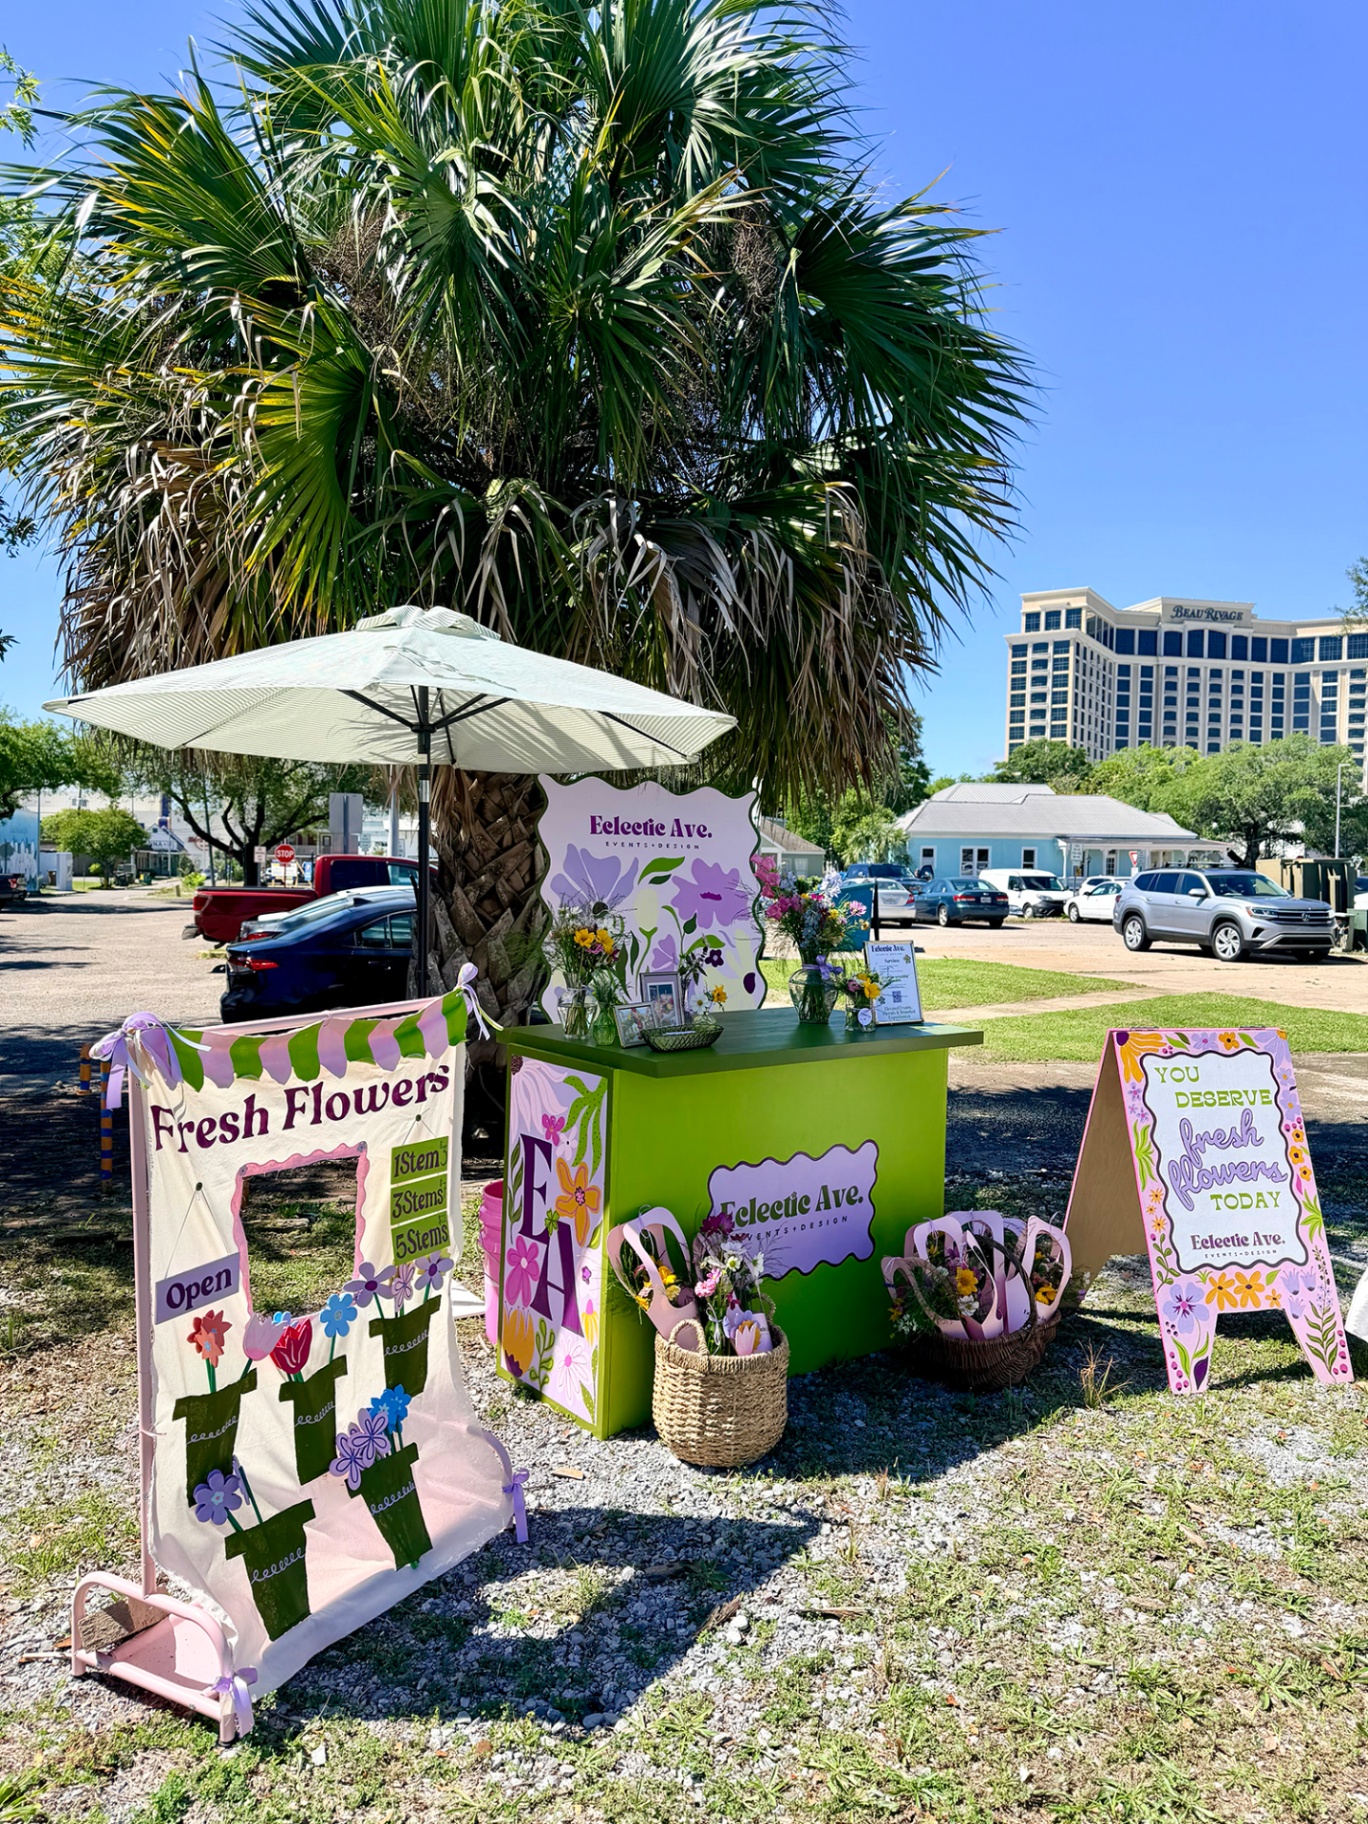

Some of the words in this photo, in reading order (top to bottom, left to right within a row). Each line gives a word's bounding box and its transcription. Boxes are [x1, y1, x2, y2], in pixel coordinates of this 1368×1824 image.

[590, 815, 666, 836] Eclectic
[670, 818, 713, 839] Ave.
[276, 850, 294, 858] STOP
[1154, 1066, 1200, 1084] YOU
[150, 1093, 269, 1153] Fresh
[282, 1065, 449, 1131] Flowers
[1175, 1089, 1273, 1108] DESERVE
[1179, 1108, 1264, 1169] fresh
[1168, 1154, 1288, 1211] flowers
[815, 1184, 864, 1212] Ave.
[1210, 1191, 1281, 1211] TODAY
[747, 1215, 848, 1241] VENTS+DESIGN
[1190, 1233, 1250, 1250] Eclectic
[1253, 1231, 1286, 1247] Ave.
[166, 1268, 232, 1310] Open
